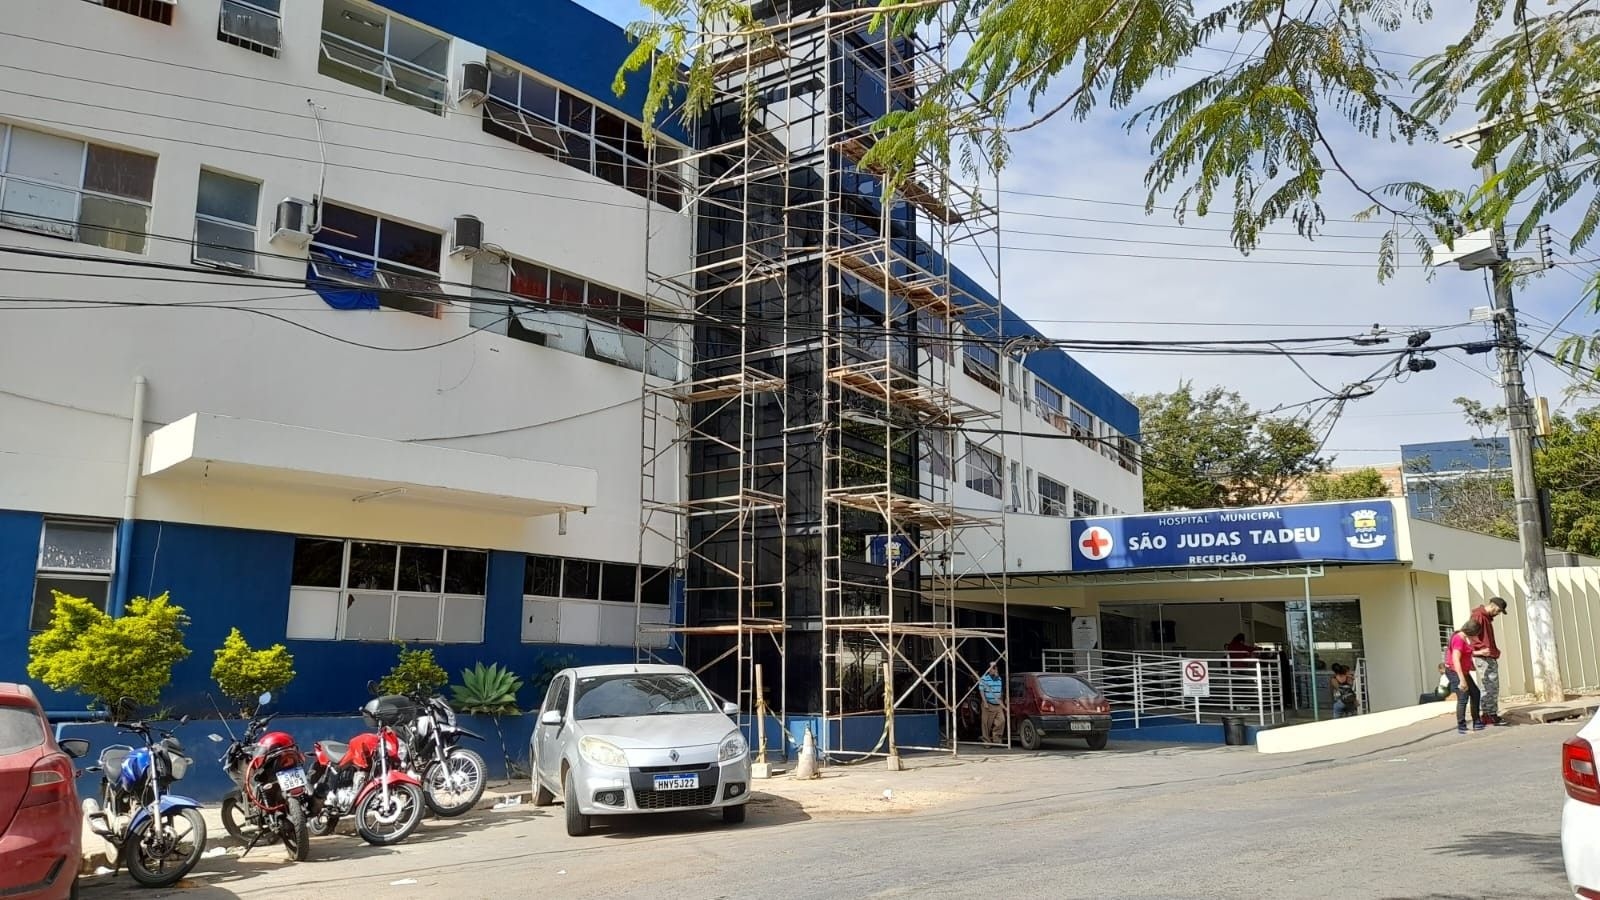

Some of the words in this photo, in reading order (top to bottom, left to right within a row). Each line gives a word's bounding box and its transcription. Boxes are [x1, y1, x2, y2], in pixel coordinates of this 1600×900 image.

[1159, 515, 1209, 526] HOSPITAL
[1220, 510, 1282, 522] MUNICIPAL
[1128, 532, 1167, 550] SÃO
[1177, 531, 1241, 549] JUDAS
[1249, 526, 1321, 545] TADEU
[1189, 551, 1247, 564] RECEPÇÃO
[658, 779, 694, 788] HNY5J22
